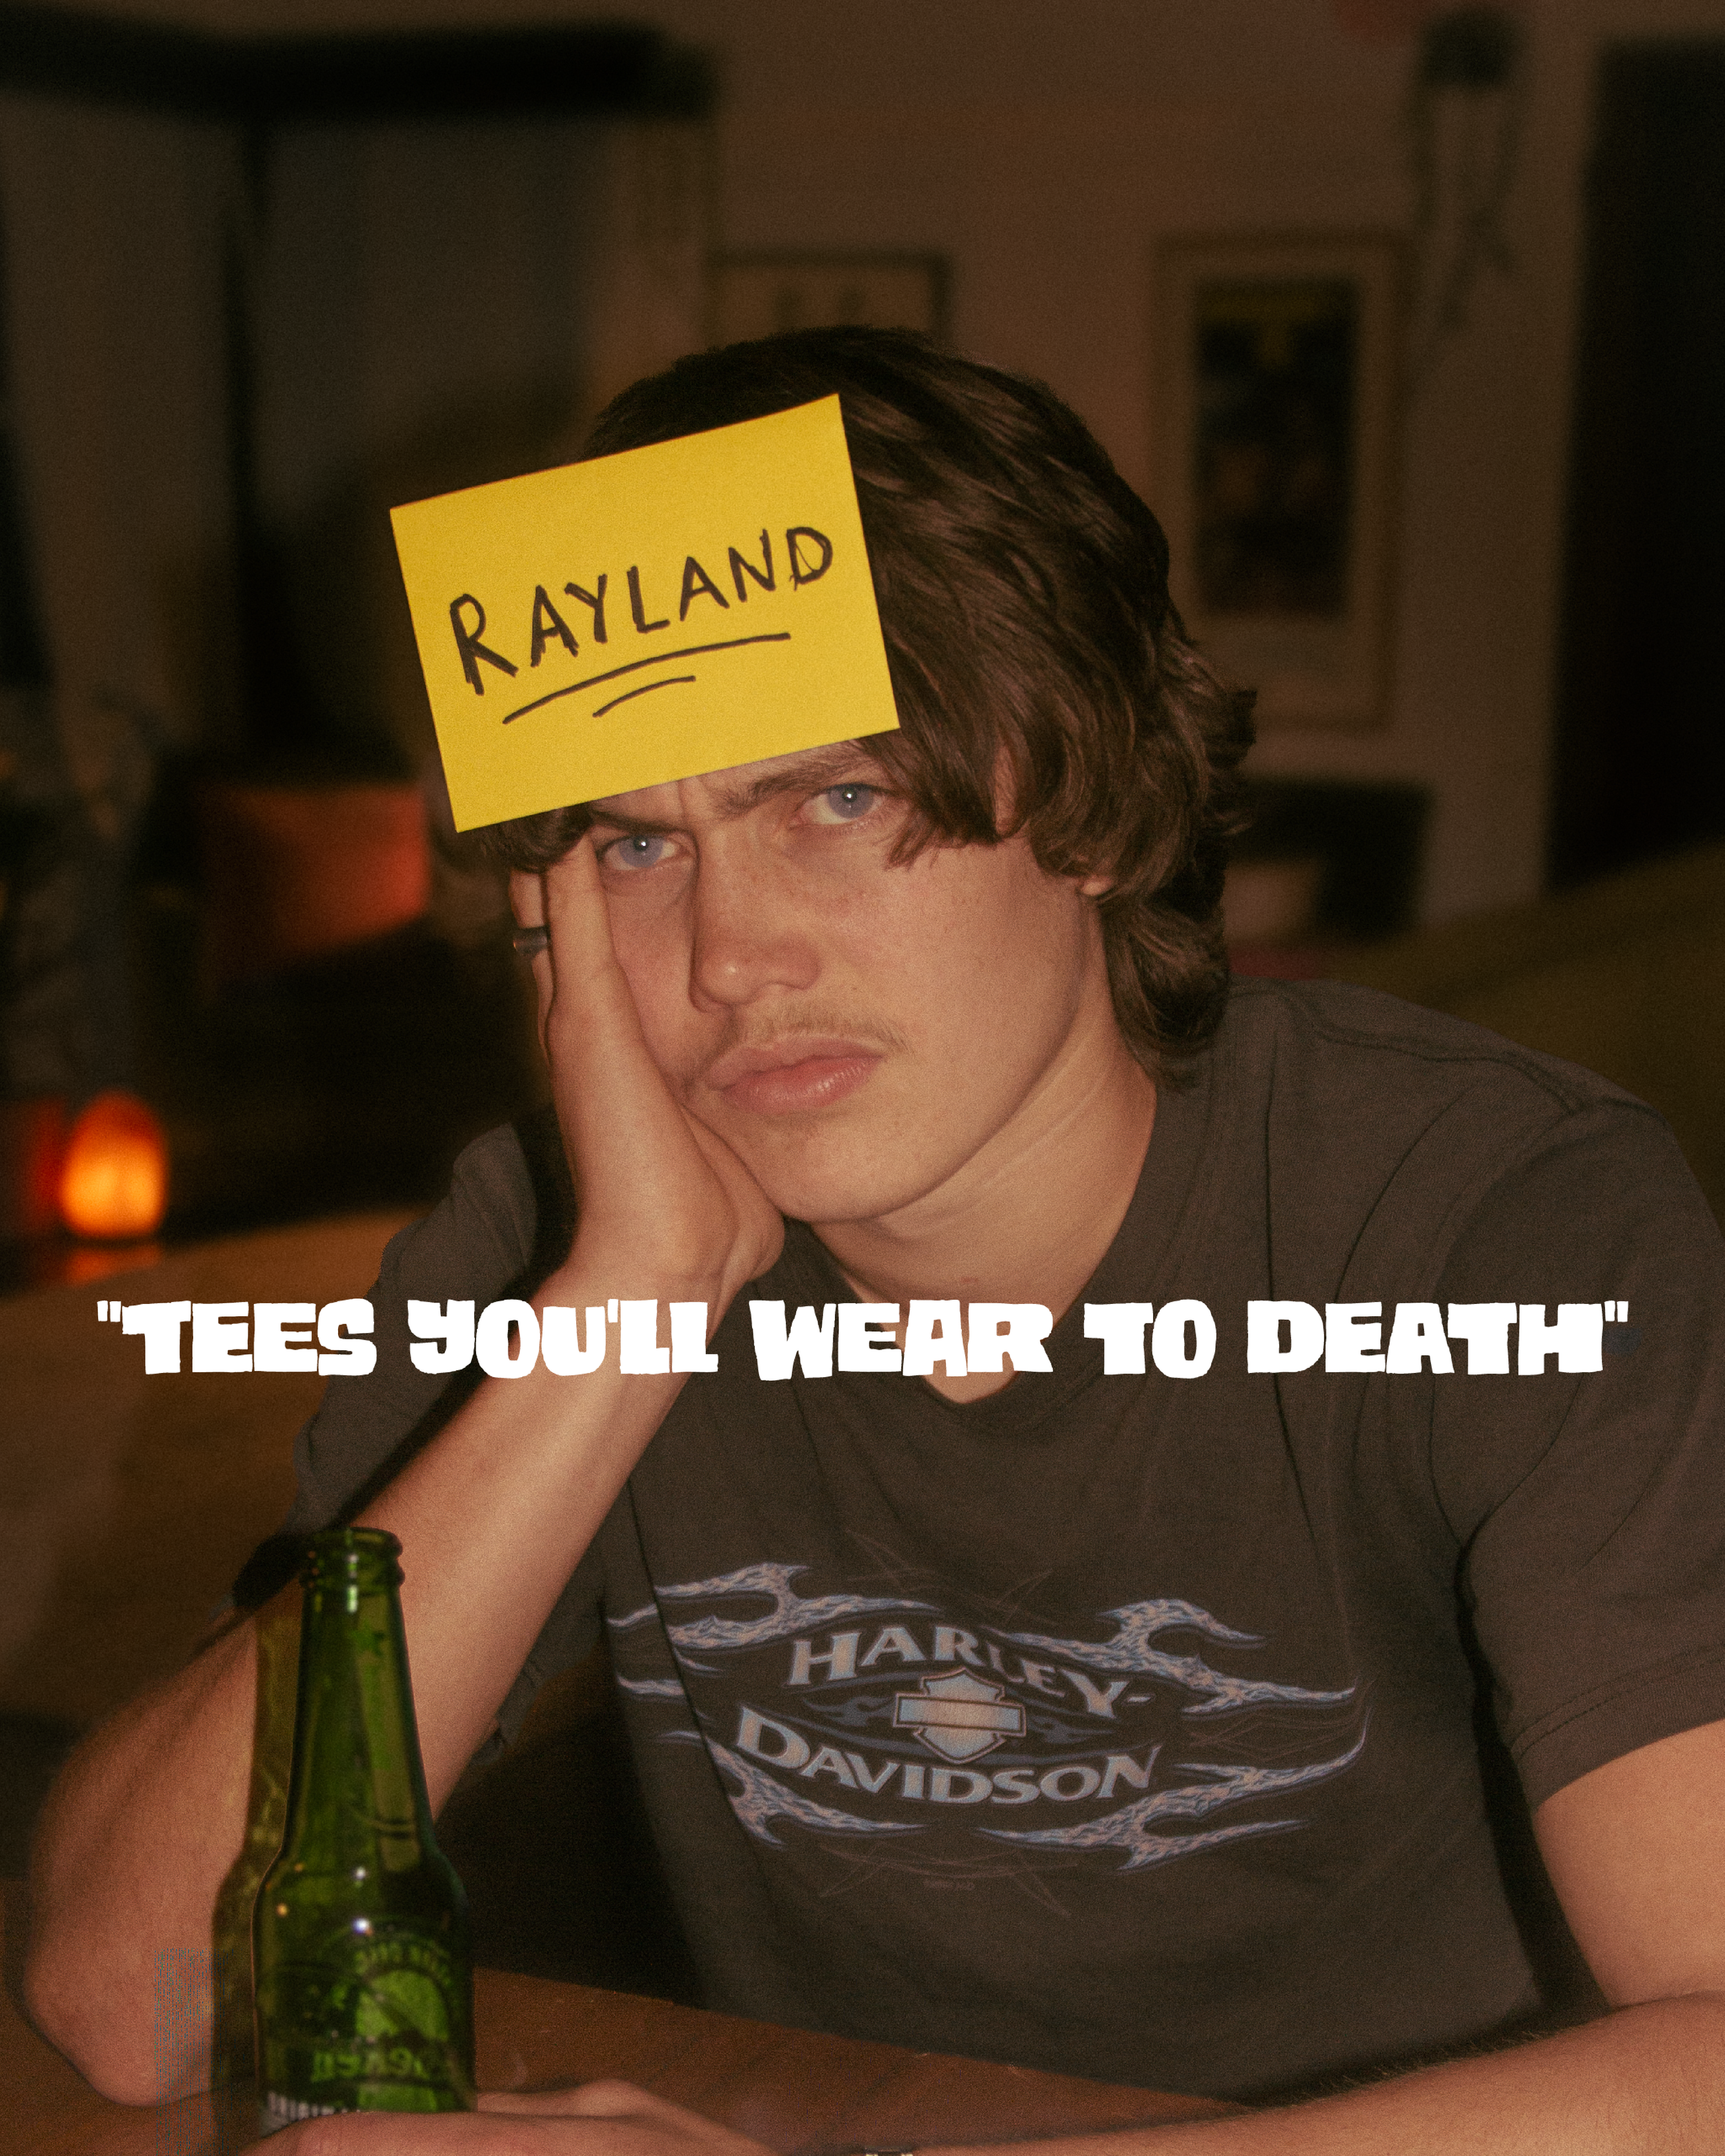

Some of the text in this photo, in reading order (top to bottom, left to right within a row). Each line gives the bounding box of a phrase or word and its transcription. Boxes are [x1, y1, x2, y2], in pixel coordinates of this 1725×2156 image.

[449, 526, 834, 696] RAYLAND
[787, 1625, 1153, 1719] HARLEY-
[736, 1706, 1162, 1804] DAVIDSON
